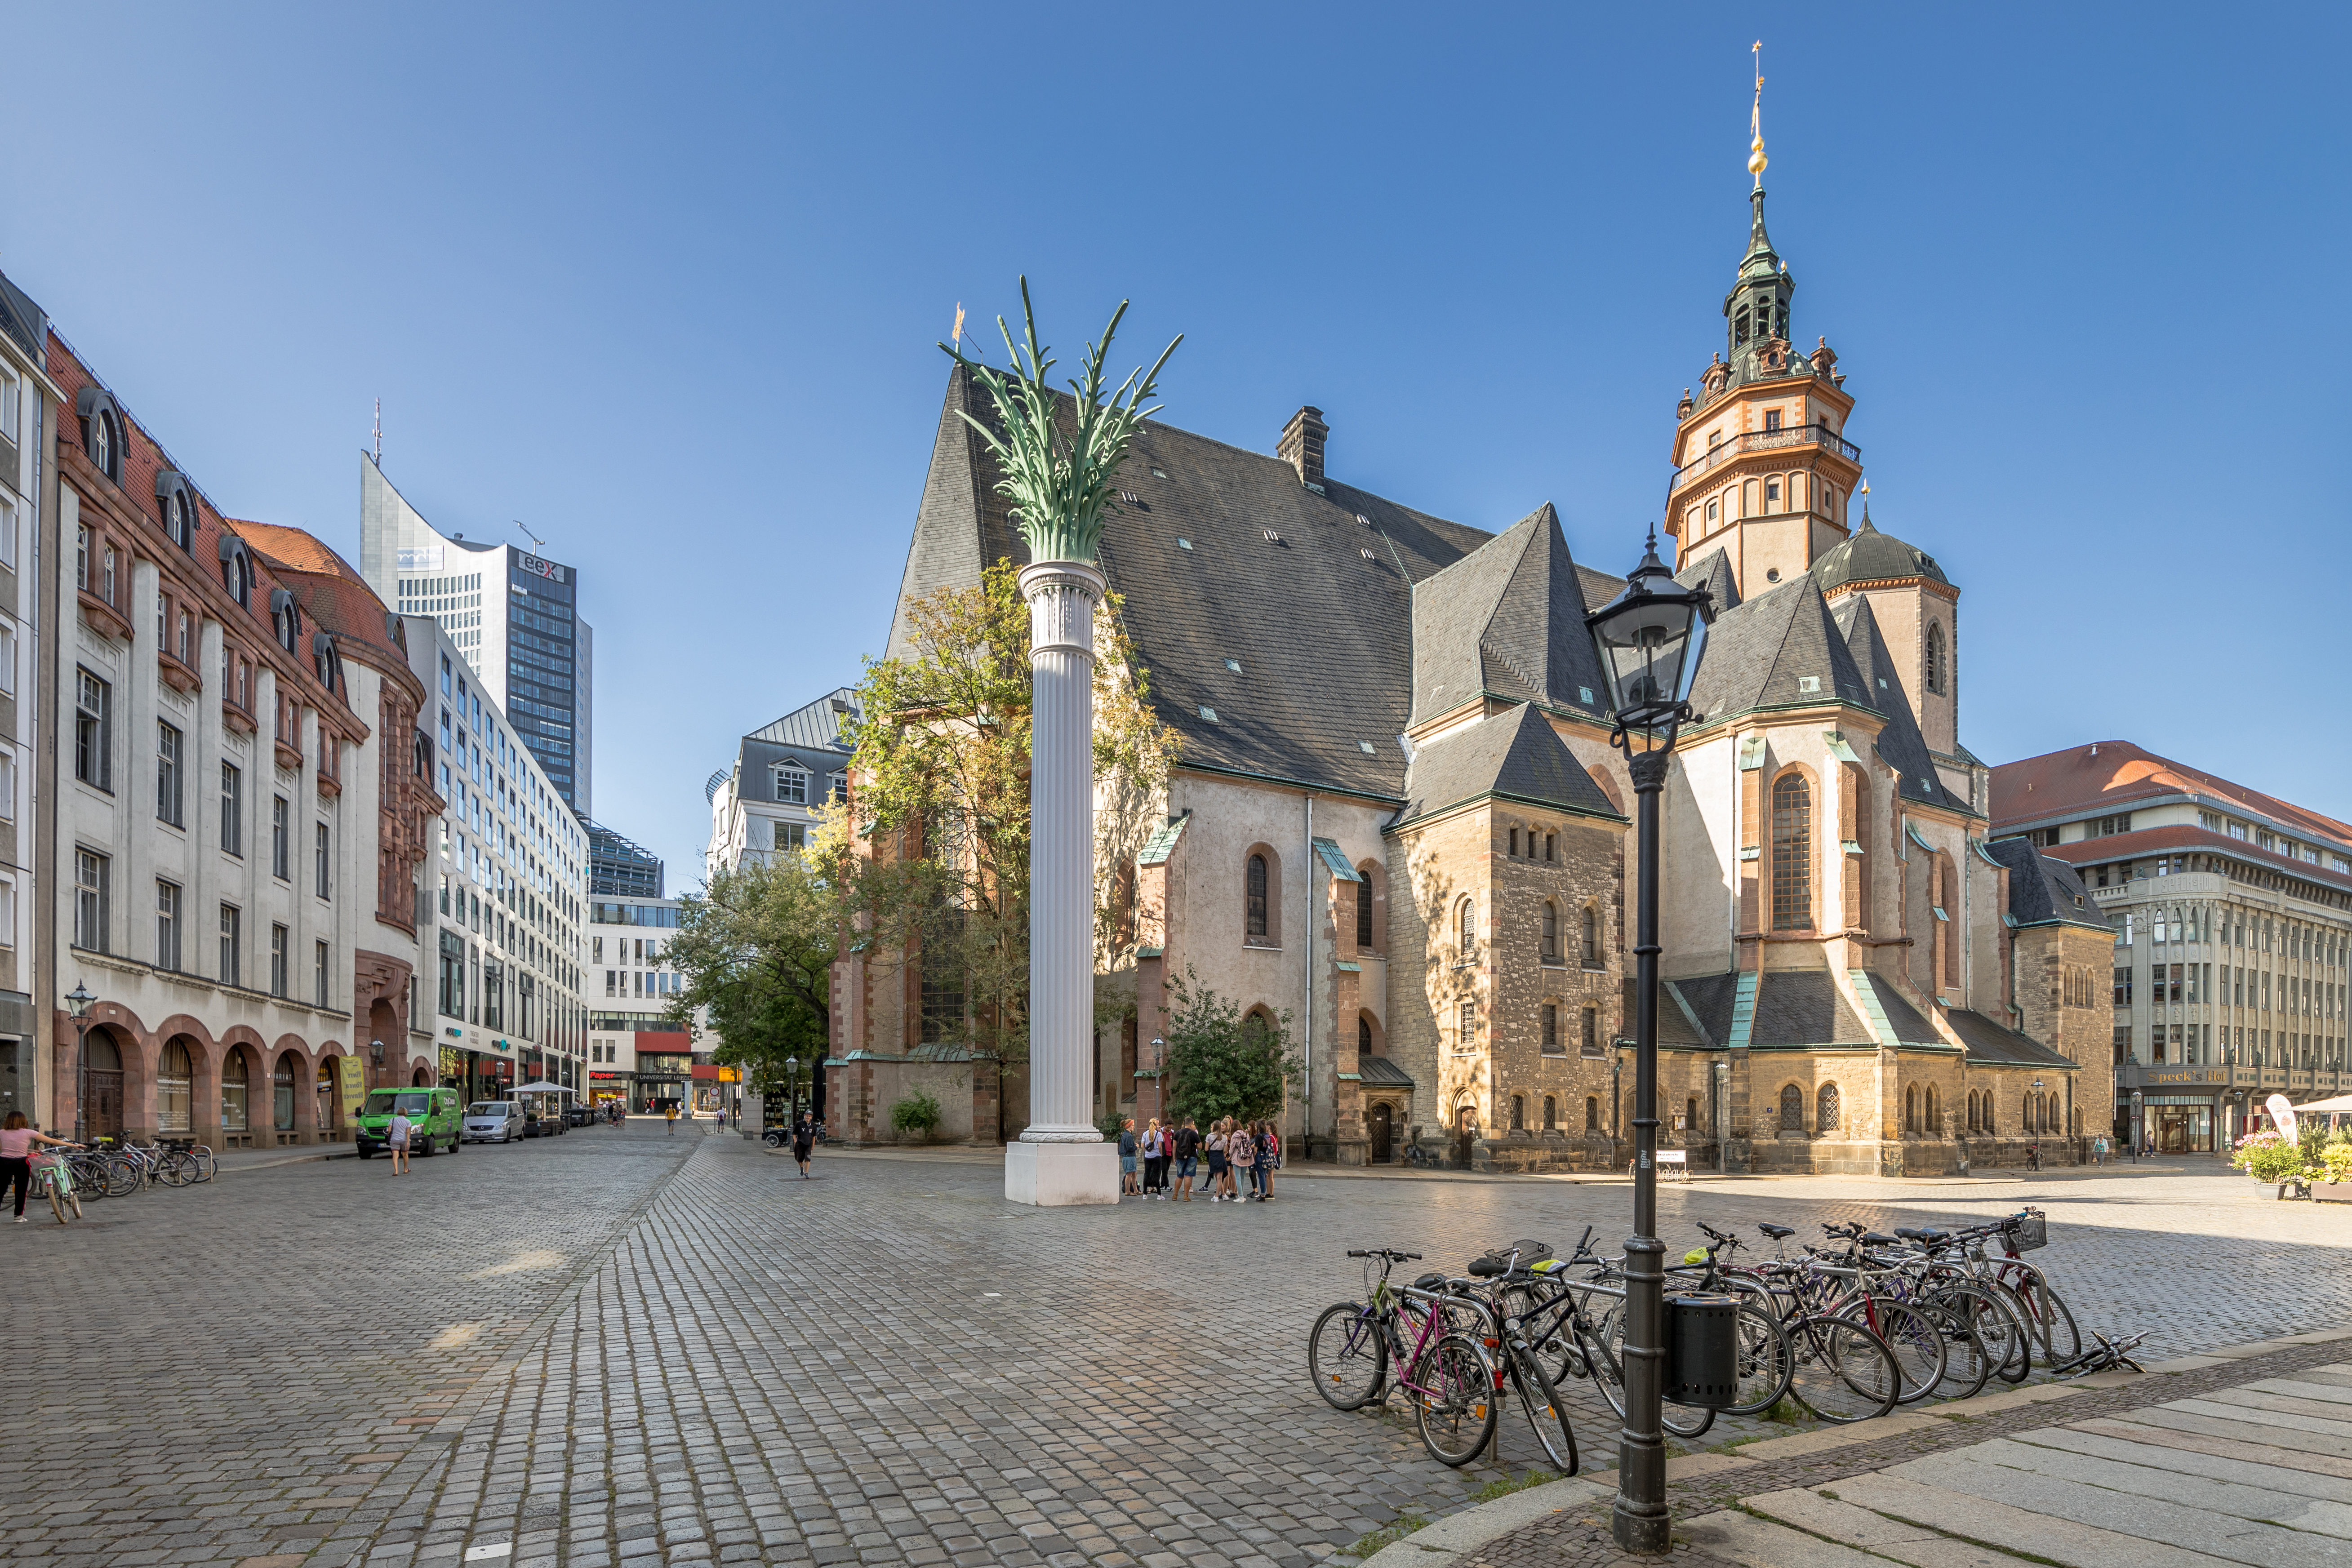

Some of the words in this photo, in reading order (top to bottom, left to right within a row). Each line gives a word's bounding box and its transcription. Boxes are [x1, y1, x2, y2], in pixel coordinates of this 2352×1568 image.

[525, 556, 557, 580] eex
[590, 1072, 615, 1080] Paper
[2207, 1071, 2226, 1081] Hof
[444, 1097, 455, 1106] CityClean
[1542, 1317, 1560, 1338] CALIFORNIA
